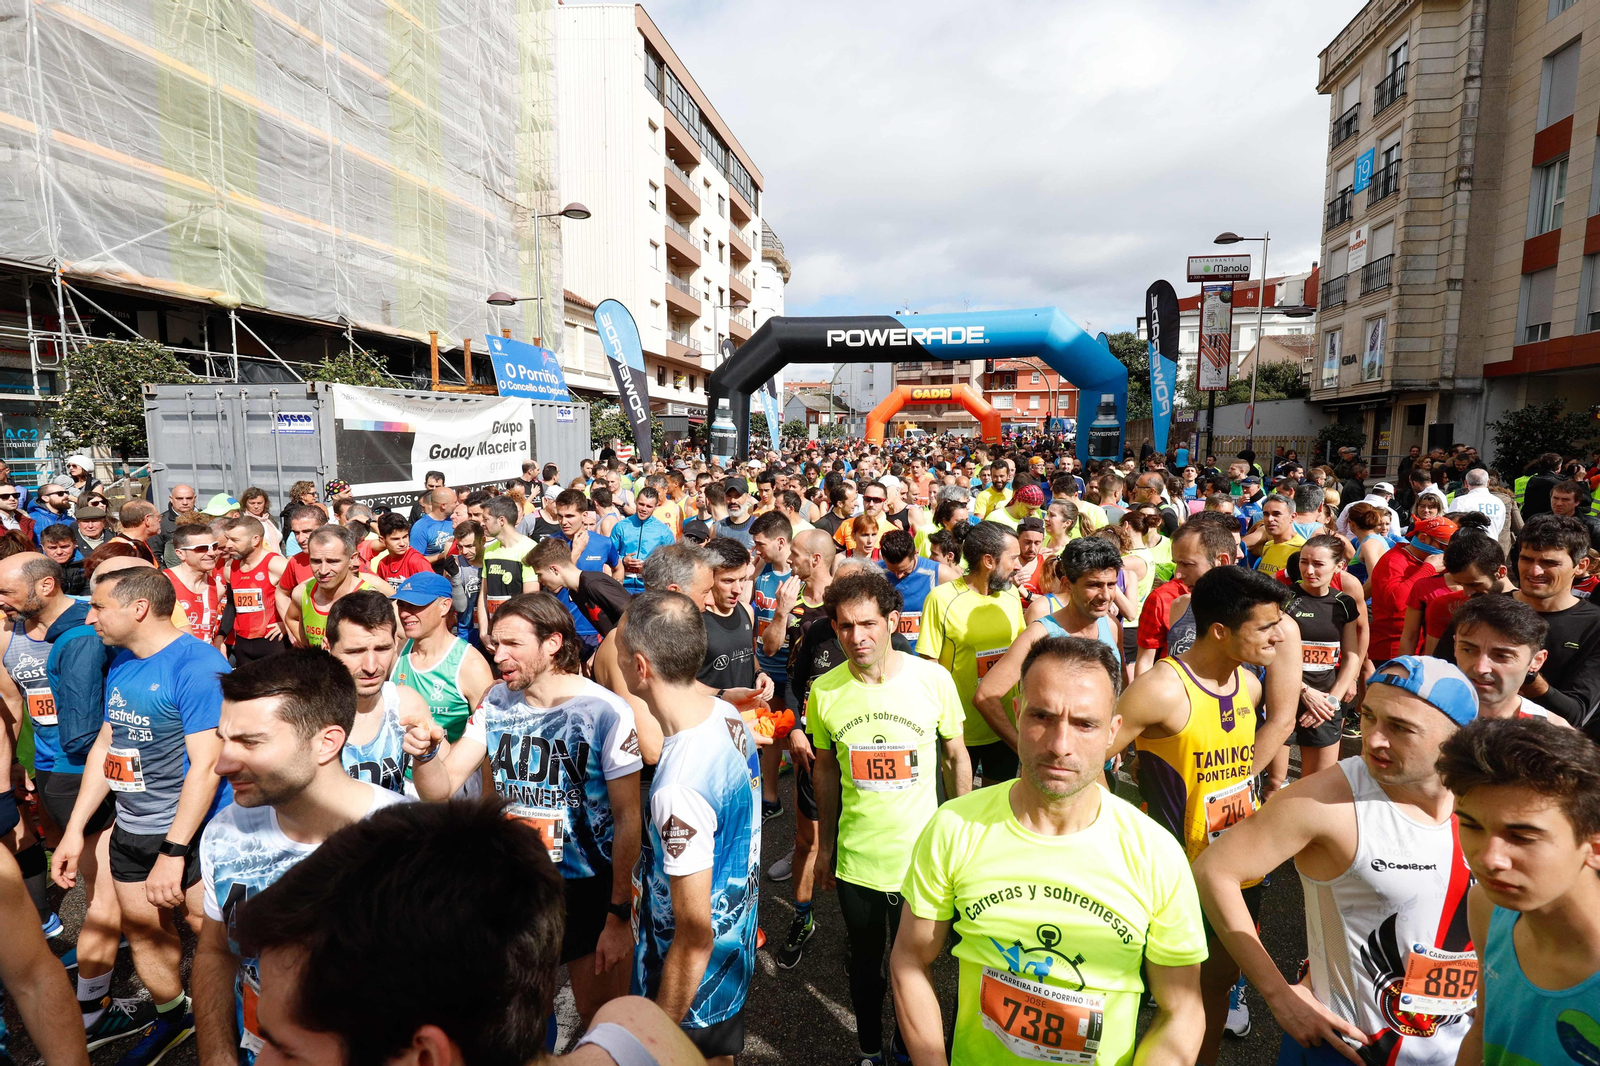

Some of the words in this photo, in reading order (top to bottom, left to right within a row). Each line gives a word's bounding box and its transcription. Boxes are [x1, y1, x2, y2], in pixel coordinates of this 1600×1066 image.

[1358, 160, 1370, 184] 19
[1213, 264, 1249, 273] Manolo
[827, 325, 986, 348] POWERADE
[1341, 353, 1357, 366] GIA
[505, 362, 517, 378] O
[517, 364, 559, 385] Porriño
[499, 379, 507, 390] O
[507, 381, 538, 393] Concello
[538, 384, 547, 394] do
[912, 387, 952, 400] GADIS
[5, 428, 39, 440] AC2
[491, 420, 523, 435] Grupo
[428, 443, 475, 461] Godoy
[476, 439, 528, 457] Maceira
[237, 595, 253, 607] 923
[1303, 649, 1328, 665] 832
[834, 713, 864, 742] Carreras
[865, 712, 871, 723] y
[872, 711, 925, 738] sobremesas
[490, 732, 590, 786] ADN
[866, 758, 897, 780] 153
[1221, 799, 1246, 828] 214
[964, 884, 1023, 921] Carreras
[1027, 884, 1037, 901] y
[1043, 884, 1134, 945] sobremesas
[986, 968, 999, 979] XIII
[999, 973, 1031, 991] CARREIRA
[1033, 986, 1042, 994] DE
[1043, 988, 1050, 997] O
[1423, 967, 1479, 998] 889
[1024, 994, 1047, 1009] JOSE
[1002, 996, 1065, 1048] 738
[1399, 1021, 1438, 1037] GEMINA
